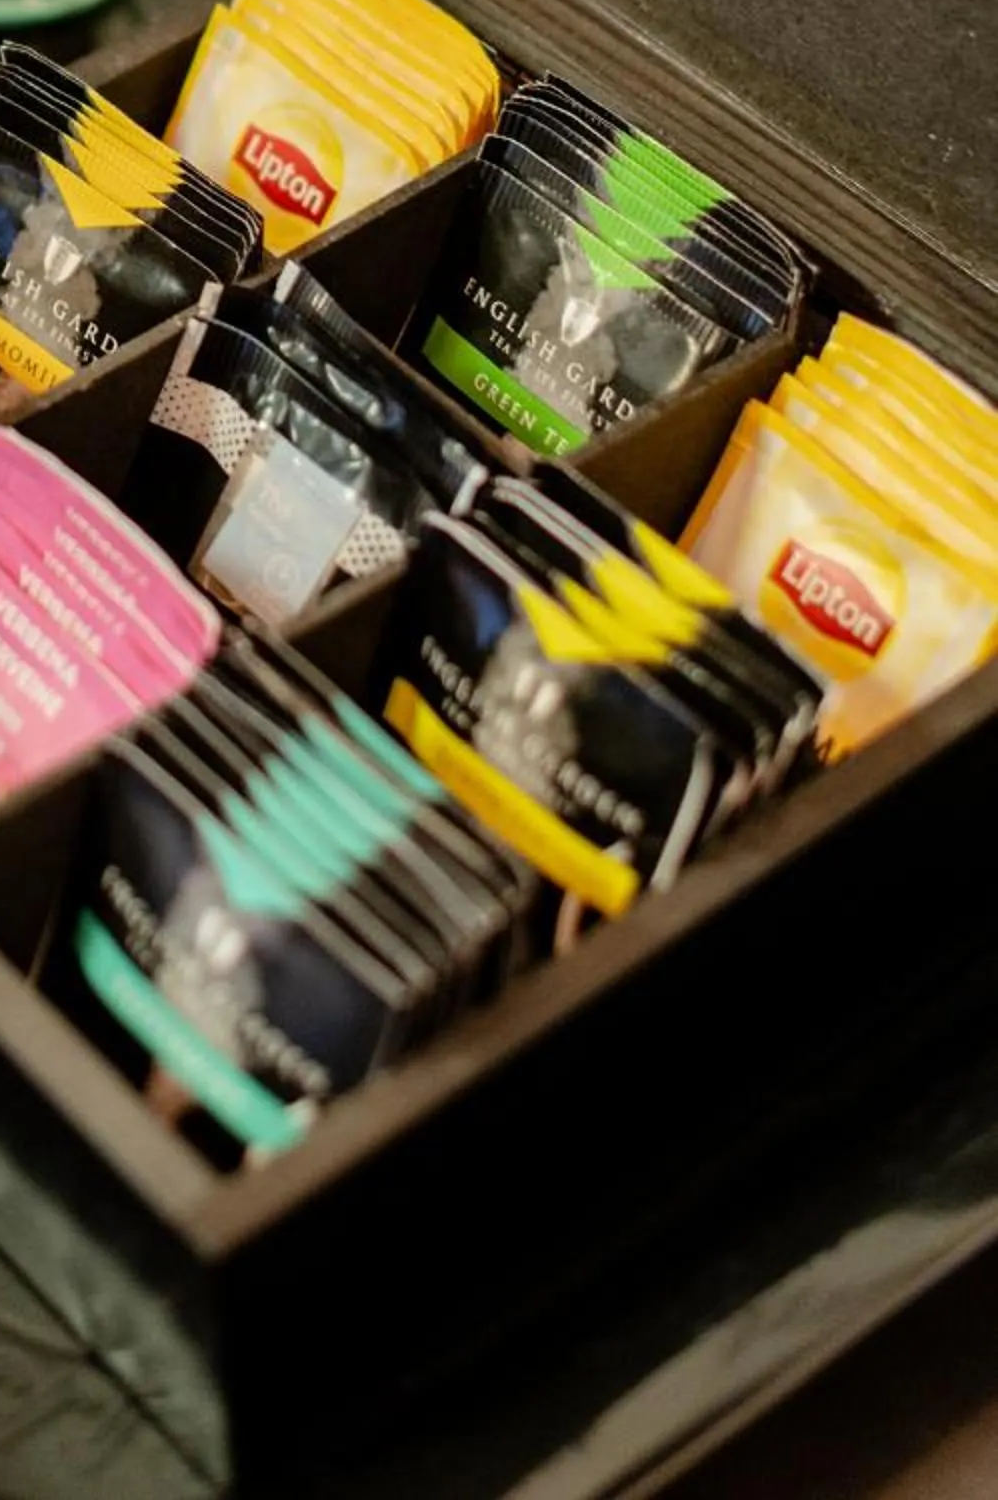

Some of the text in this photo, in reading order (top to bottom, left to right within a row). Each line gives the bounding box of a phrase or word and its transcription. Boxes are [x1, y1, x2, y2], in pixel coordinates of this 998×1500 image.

[242, 132, 326, 217] Lipton
[52, 298, 119, 355] GARD
[462, 276, 635, 421] ENGLISH GARD
[489, 329, 512, 355] TEA
[473, 372, 572, 457] GREEN TE
[780, 549, 880, 650] Lipton
